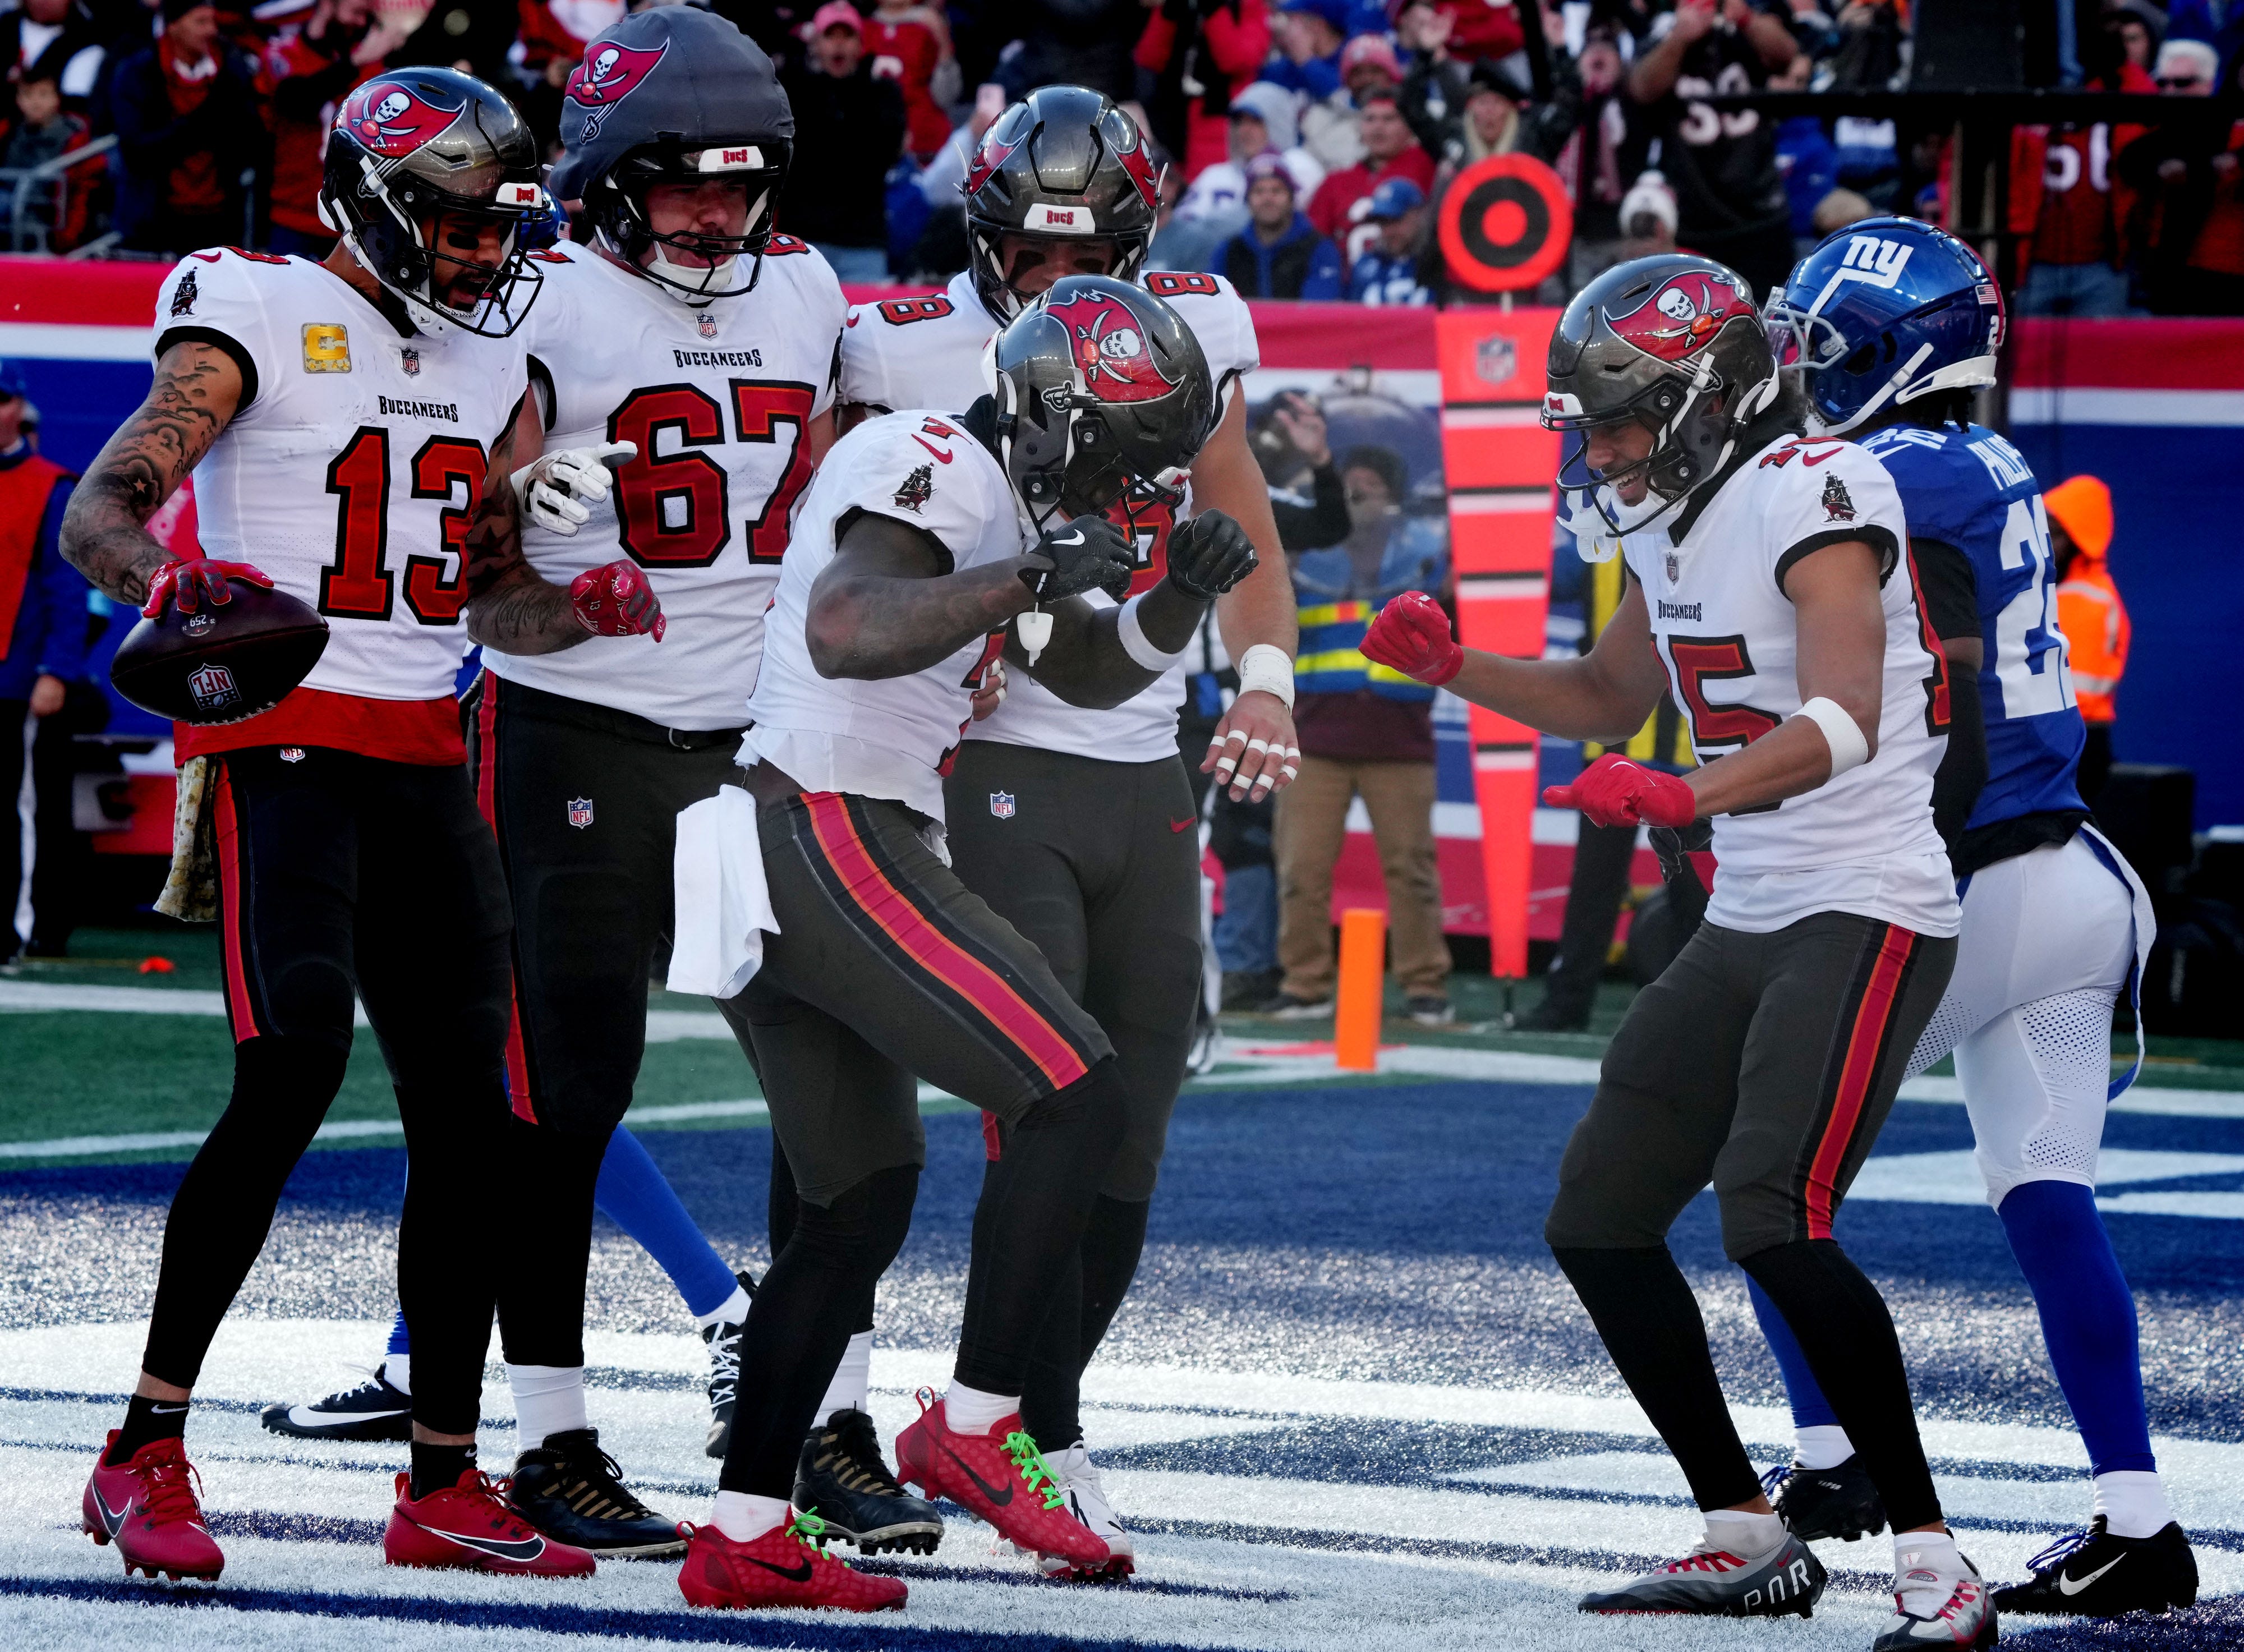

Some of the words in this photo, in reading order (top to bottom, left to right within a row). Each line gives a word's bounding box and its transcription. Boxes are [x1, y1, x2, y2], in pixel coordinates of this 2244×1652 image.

[701, 324, 716, 335] NFL
[306, 326, 347, 360] C
[404, 358, 419, 371] NFL
[673, 349, 762, 370] BUCCANEERS
[378, 395, 459, 423] BUCCANEERS
[606, 378, 817, 568] 67
[318, 425, 489, 625] 13
[1657, 599, 1702, 623] BUCCANEERS
[192, 671, 231, 695] NFL
[1650, 633, 1784, 816] 5
[572, 811, 590, 823] NFL
[994, 803, 1012, 815] NFL
